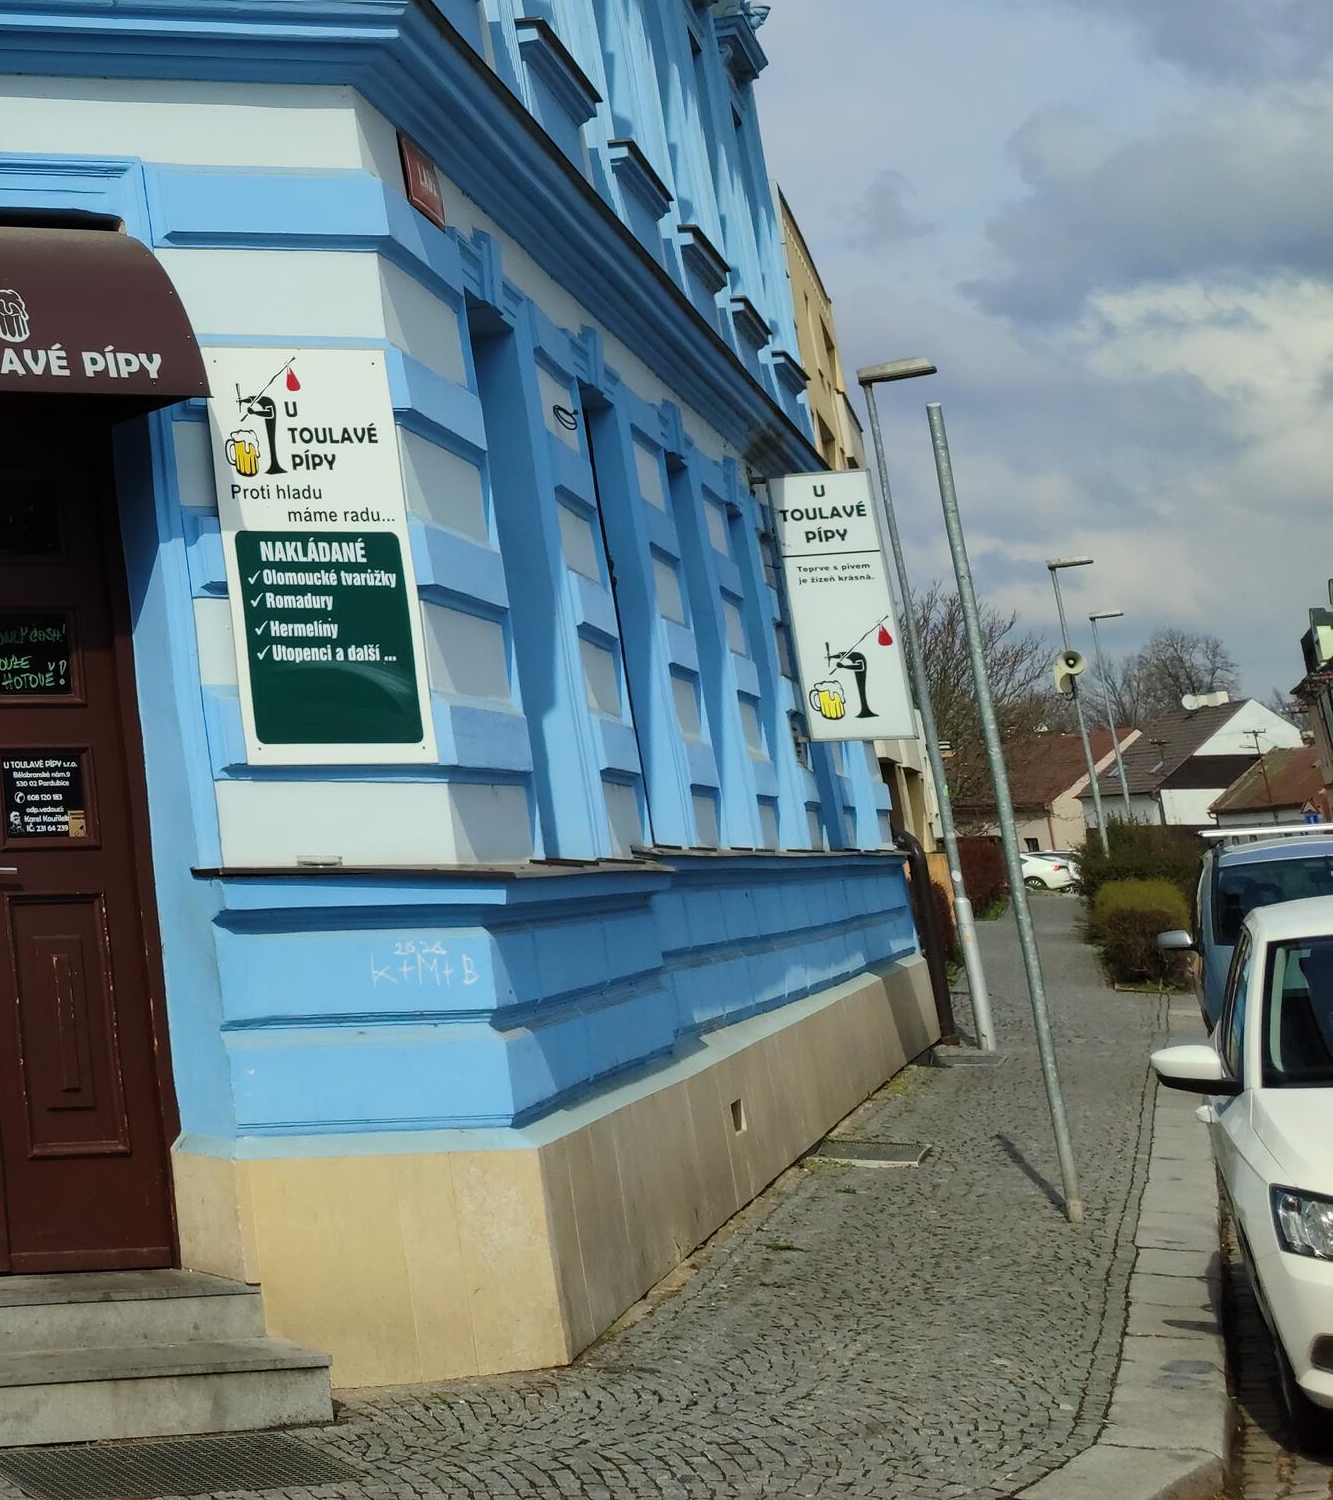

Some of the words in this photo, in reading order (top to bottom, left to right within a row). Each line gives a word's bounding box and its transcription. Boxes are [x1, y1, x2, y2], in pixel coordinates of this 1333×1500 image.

[82, 345, 162, 379] PÍPY
[285, 401, 297, 417] U
[288, 423, 378, 444] TOULAVÉ
[292, 450, 336, 470] PÍPY
[231, 485, 270, 499] Proti
[277, 485, 322, 499] hladu
[813, 485, 825, 497] U
[288, 507, 337, 522] máme
[344, 507, 395, 522] radu...
[779, 501, 867, 522] TOULAVÉ
[805, 527, 848, 543] PÍPY
[260, 538, 367, 562] NAKLÁDANÉ
[842, 563, 870, 571] pivem
[263, 569, 337, 585] Olomoucké
[341, 569, 396, 588] tvarůžky
[799, 577, 807, 585] je
[265, 593, 333, 611] Romadury
[270, 620, 338, 639] Hermelíny
[272, 644, 332, 663] Utopenci
[336, 648, 344, 661] a
[348, 644, 380, 661] další
[10, 760, 44, 768] TOULAVÉ
